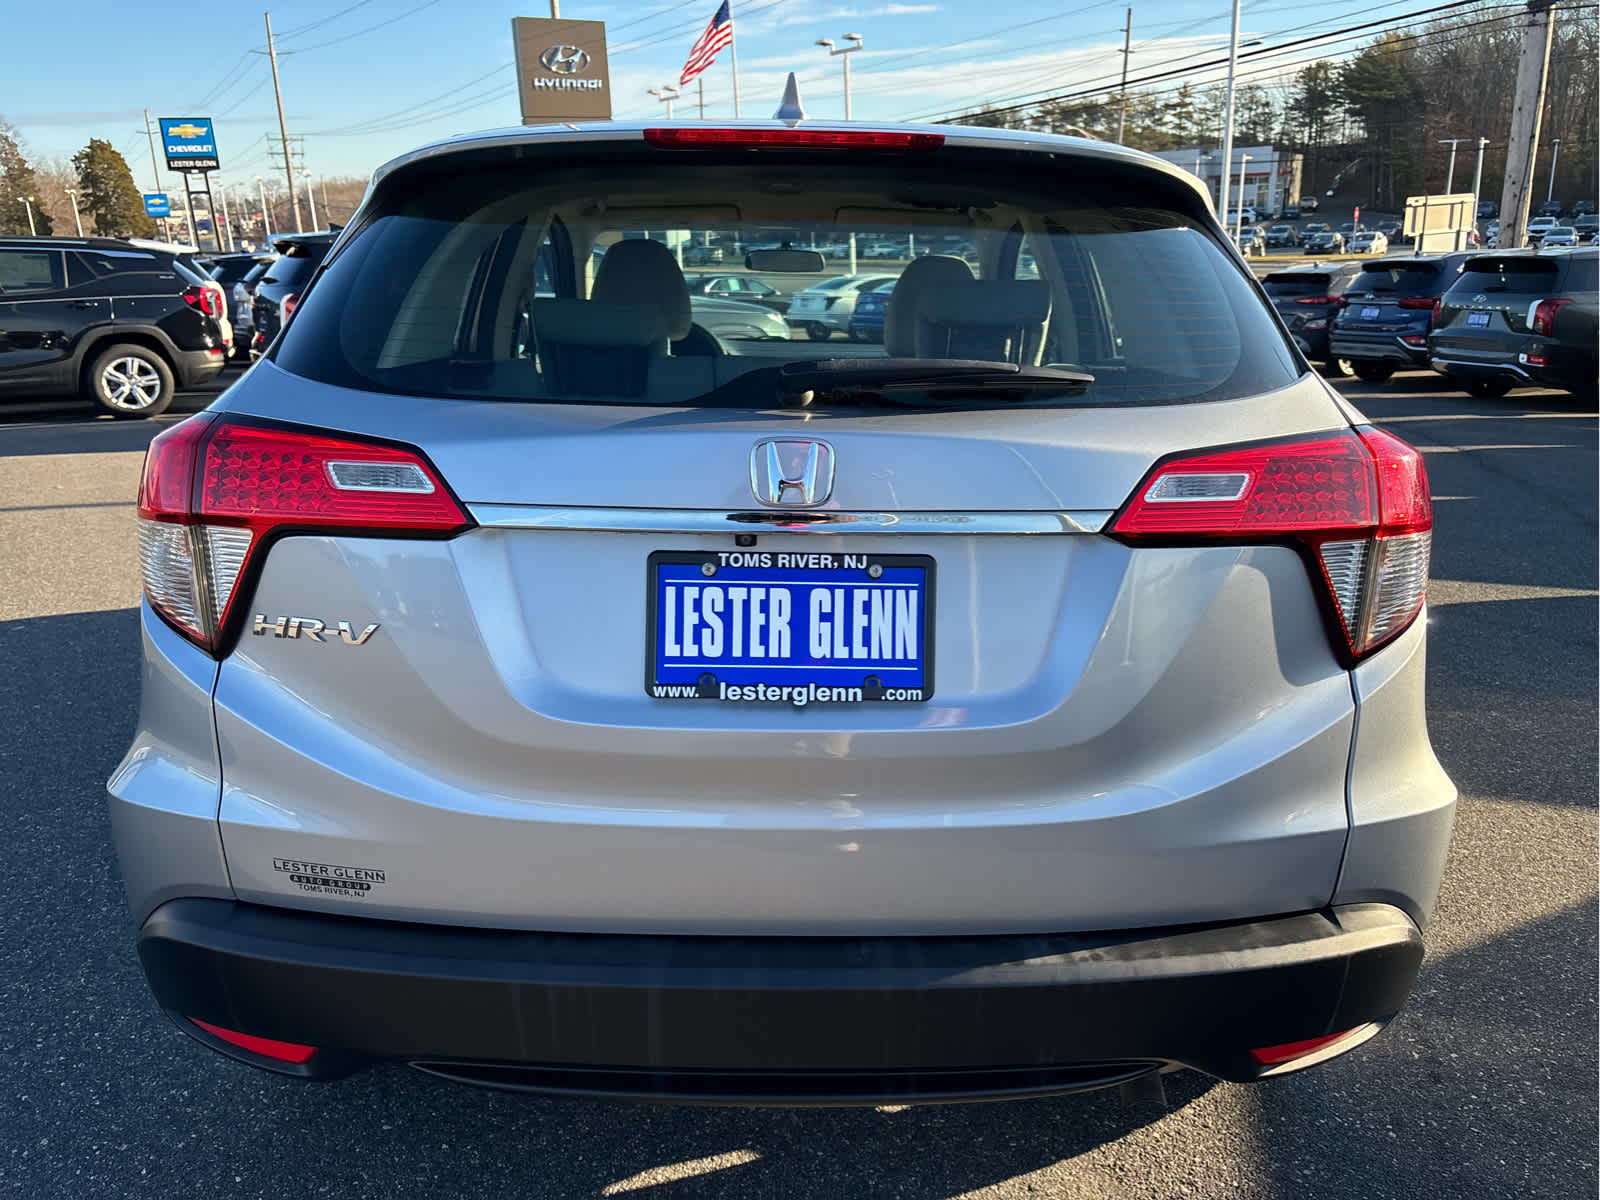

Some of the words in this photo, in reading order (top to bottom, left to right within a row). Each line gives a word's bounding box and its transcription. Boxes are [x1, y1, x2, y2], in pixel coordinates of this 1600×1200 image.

[168, 145, 212, 153] CHEVROLET
[170, 160, 194, 168] LESTER
[718, 552, 772, 568] TOMS
[777, 554, 840, 570] RIVER,
[843, 555, 868, 569] NJ
[253, 613, 381, 645] HR-V
[664, 586, 792, 658] LESTER
[809, 587, 918, 660] GLENN
[719, 682, 863, 706] lesterglenn
[273, 860, 329, 875] LESTER
[334, 868, 385, 881] GLENN
[293, 875, 322, 885] AUTO
[329, 881, 369, 890] GROUP
[297, 884, 323, 893] TOMS
[325, 887, 353, 897] RIVER,
